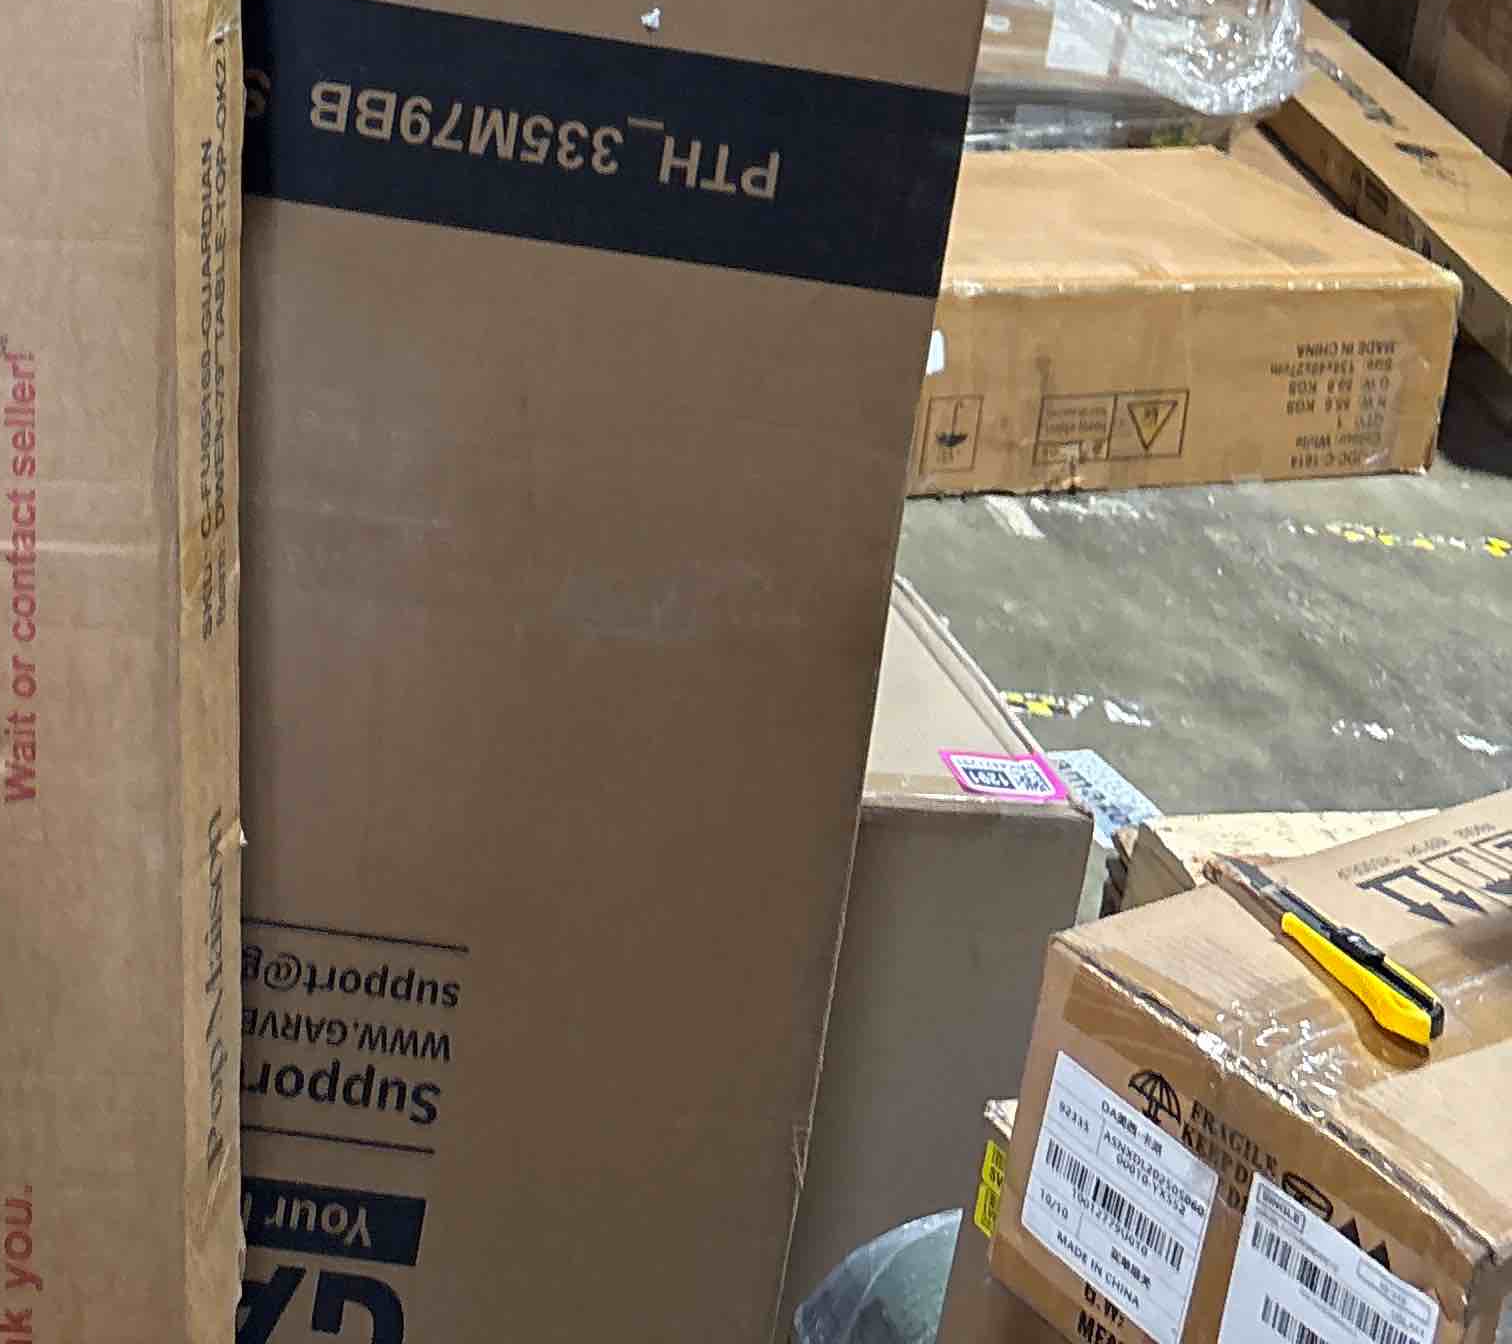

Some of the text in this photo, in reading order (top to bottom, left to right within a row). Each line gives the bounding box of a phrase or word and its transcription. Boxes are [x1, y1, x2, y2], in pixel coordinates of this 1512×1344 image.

[308, 79, 782, 200] PTH_335M79BB
[3, 487, 38, 643] contact
[11, 654, 38, 699] or
[3, 711, 38, 804] Wait
[242, 1058, 442, 1126] Suppor
[3, 1183, 44, 1292] you.
[264, 1194, 374, 1249] Your
[1055, 1230, 1089, 1266] MADE
[1089, 1256, 1104, 1278] IN
[1105, 1268, 1140, 1309] CHINA
